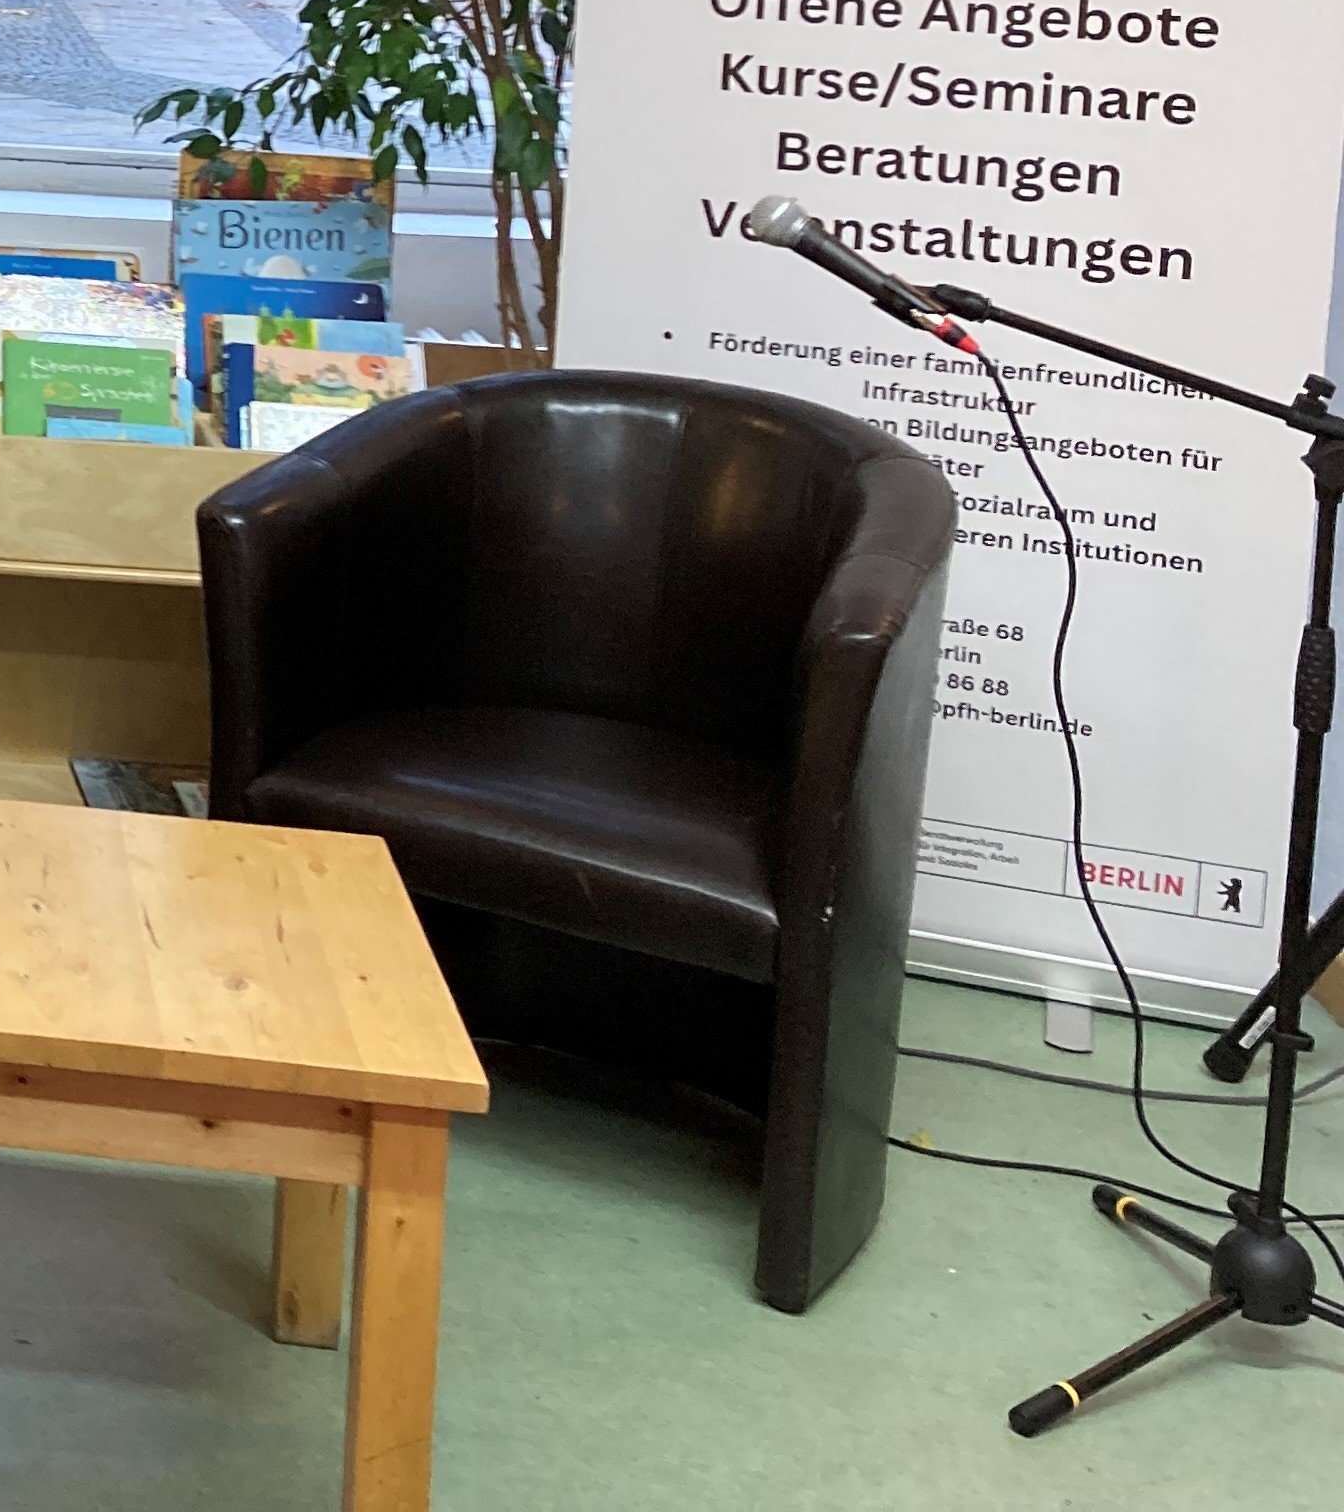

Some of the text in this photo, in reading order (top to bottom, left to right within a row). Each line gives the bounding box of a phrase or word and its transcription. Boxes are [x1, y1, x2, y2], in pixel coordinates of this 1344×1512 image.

[720, 52, 1197, 126] Kurse/Seminare
[776, 131, 1121, 202] Beratungen
[218, 209, 346, 252] Bienen
[708, 331, 843, 367] Förderung
[849, 346, 917, 370] einer
[924, 453, 985, 479] äter
[1180, 447, 1224, 472] für
[1103, 511, 1157, 532] und
[996, 624, 1024, 642] 68
[946, 673, 1010, 697] 86 88
[1080, 862, 1185, 897] BERLIN
